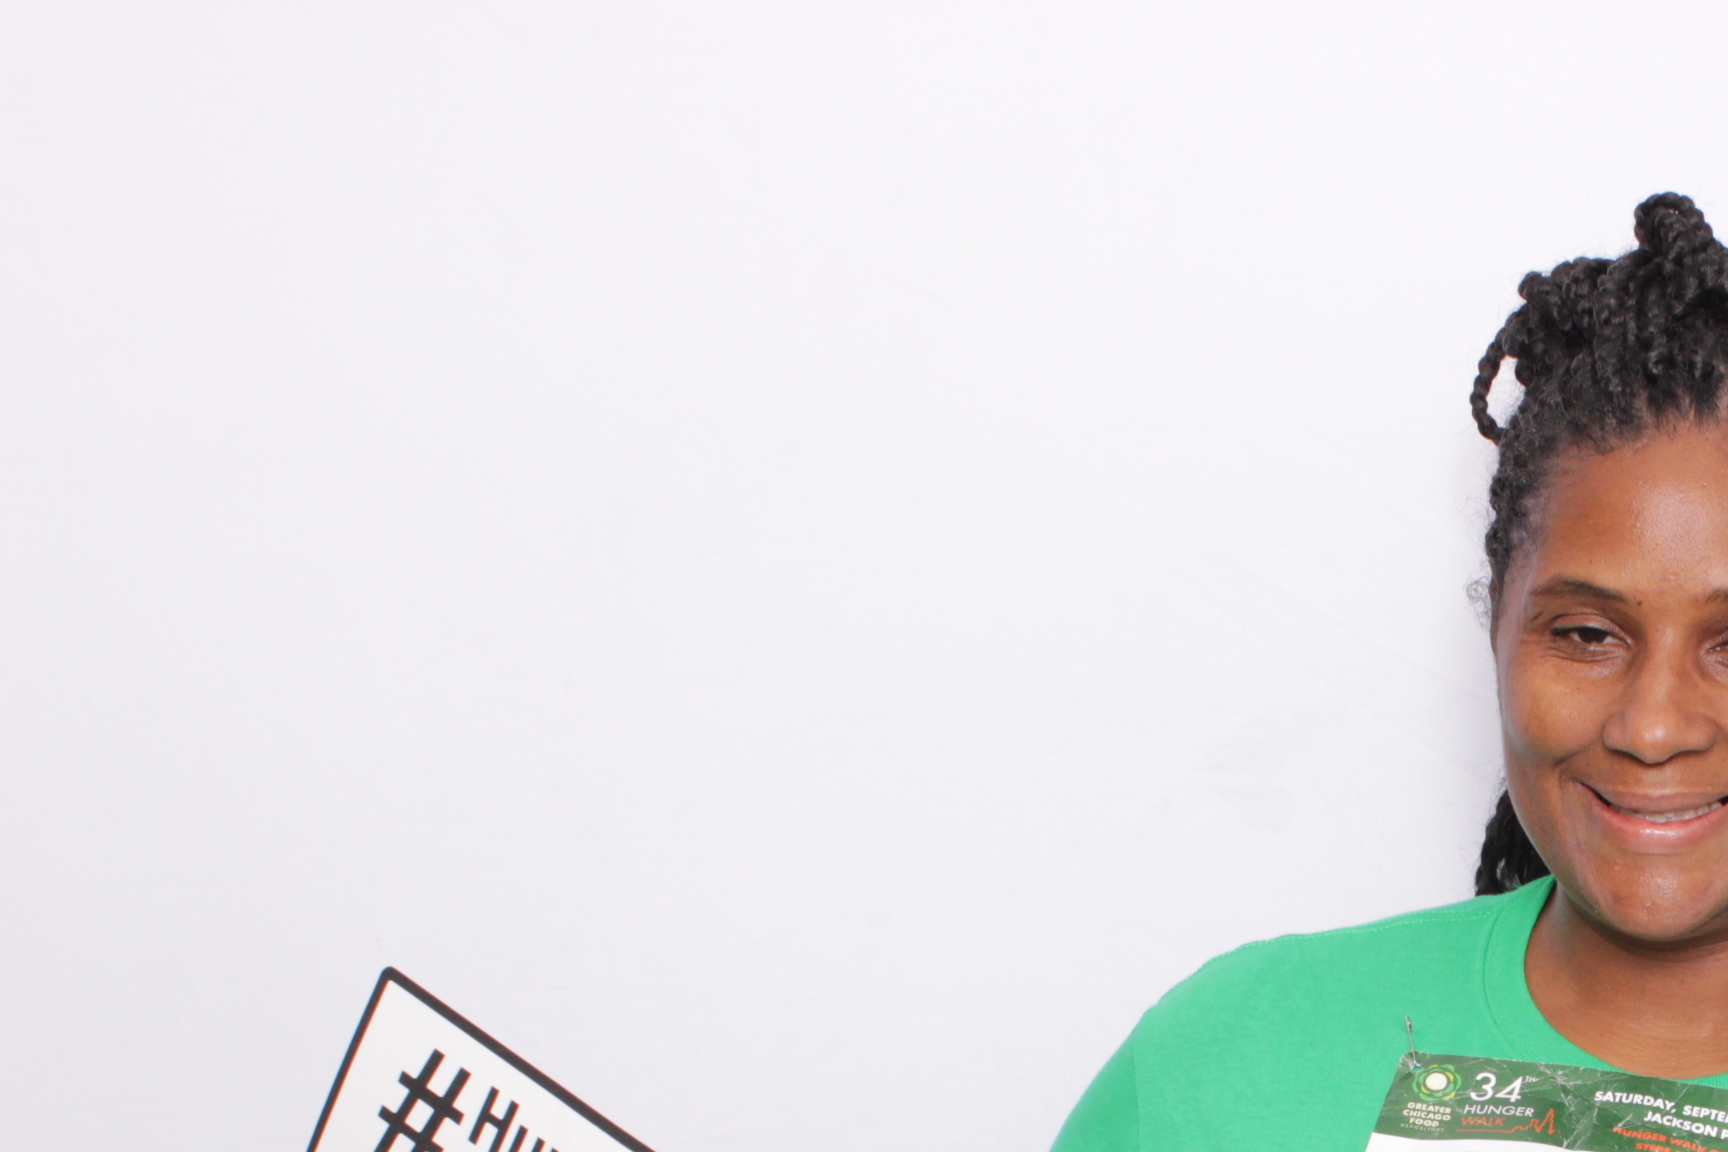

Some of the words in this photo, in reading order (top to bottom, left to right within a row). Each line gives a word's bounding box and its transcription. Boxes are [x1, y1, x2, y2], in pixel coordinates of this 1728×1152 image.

[1407, 1102, 1451, 1114] GREATER
[1594, 1091, 1677, 1114] SATURDAY,
[1403, 1109, 1451, 1121] CHICAGO
[1463, 1104, 1535, 1117] HUNGER
[1409, 1118, 1440, 1127] FOOD
[1461, 1117, 1506, 1126] WALK
[1643, 1111, 1718, 1138] JACKSON
[1612, 1126, 1667, 1142] HUNGER
